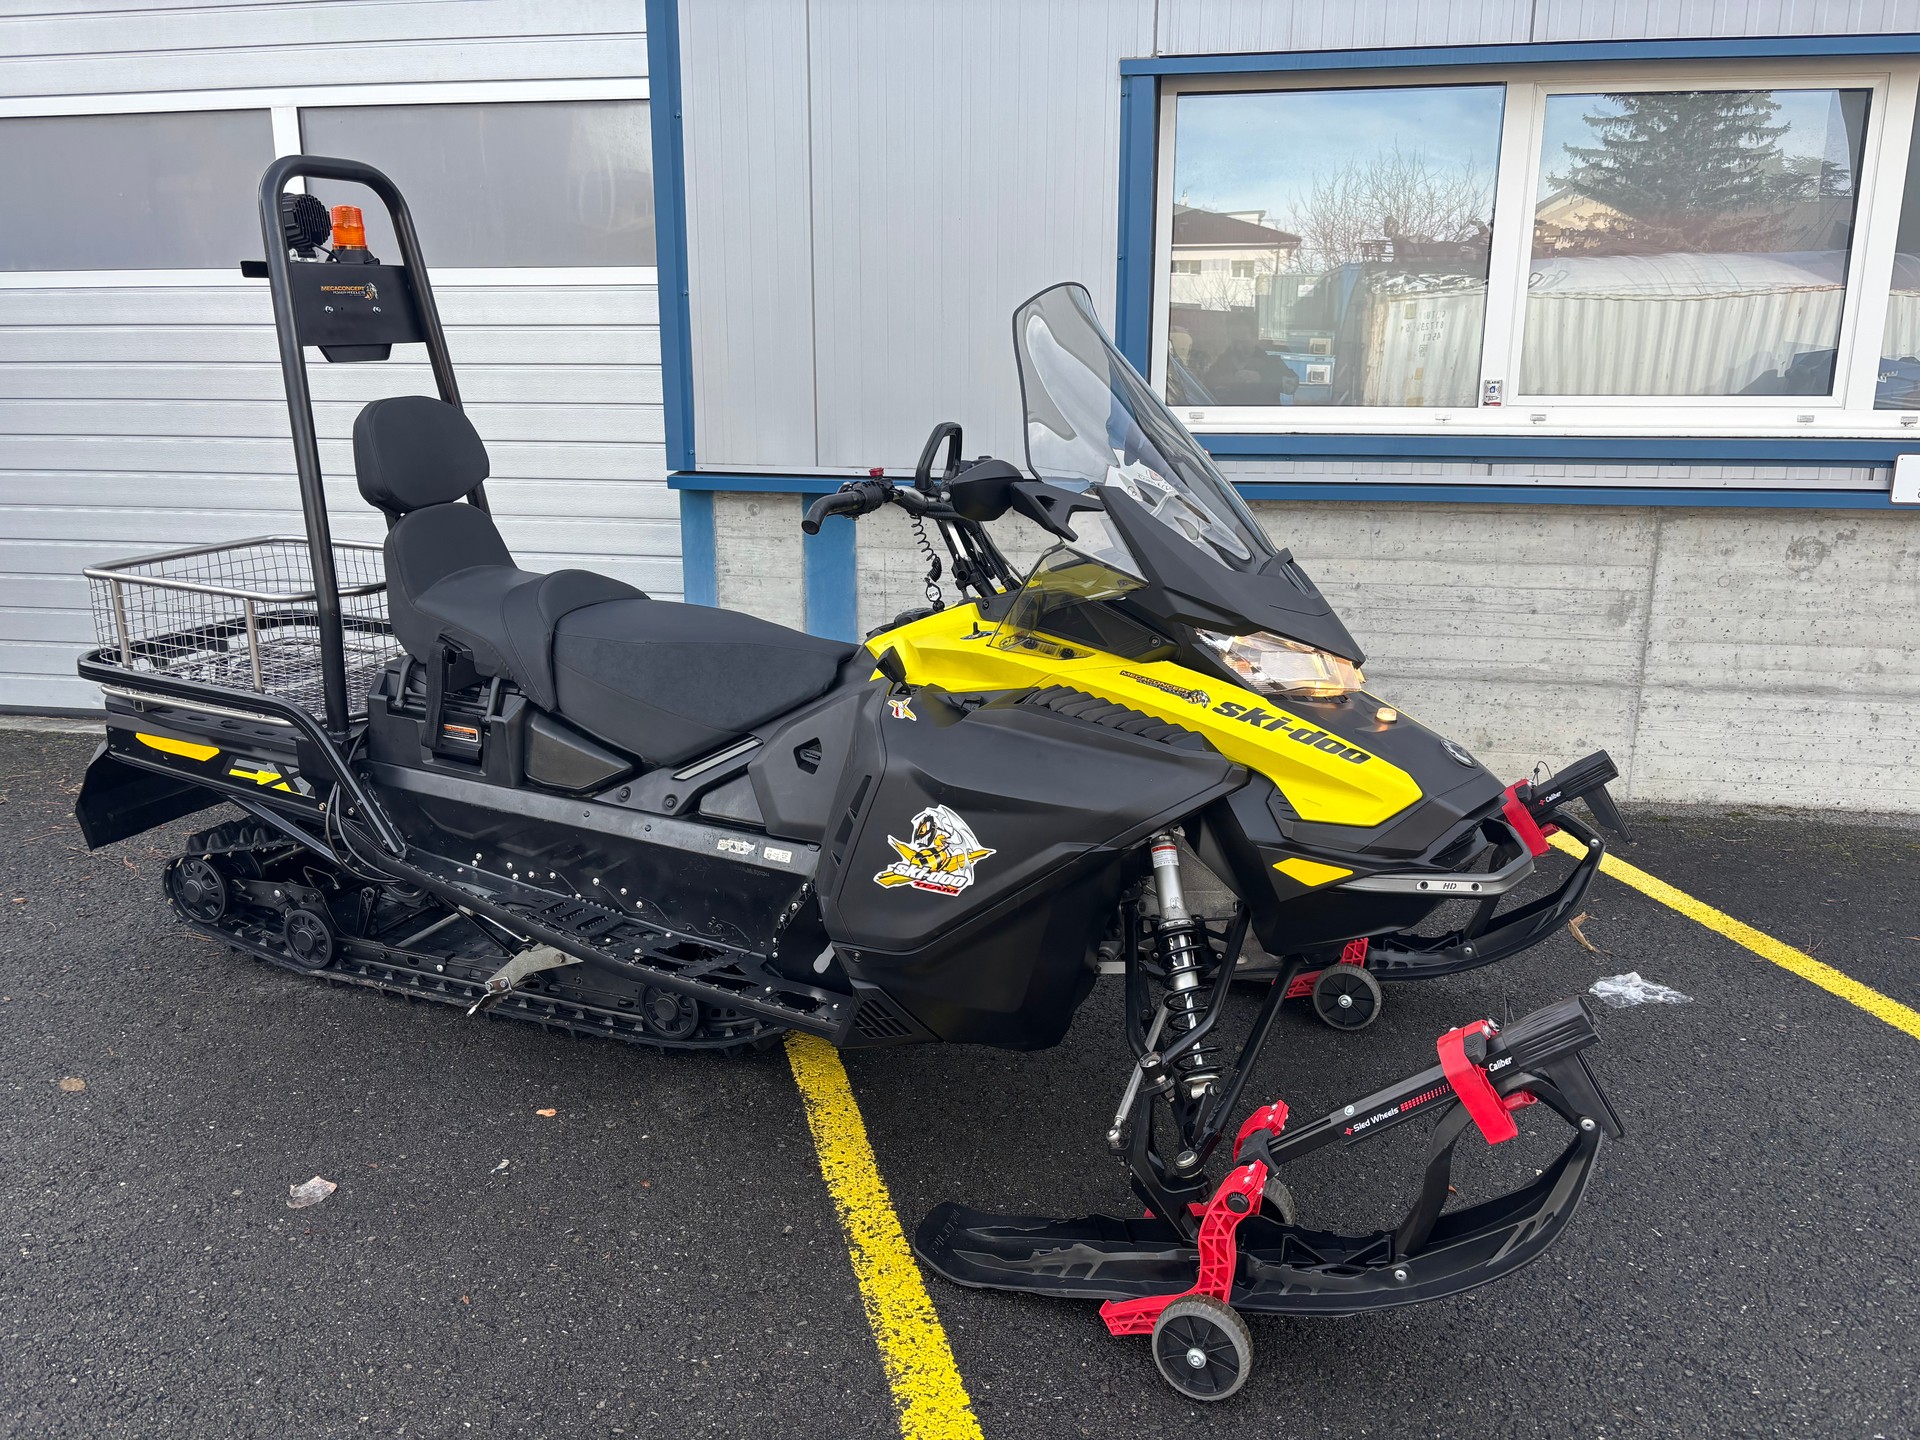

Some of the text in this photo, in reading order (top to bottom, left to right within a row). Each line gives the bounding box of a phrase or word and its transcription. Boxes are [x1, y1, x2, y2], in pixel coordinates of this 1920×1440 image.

[1212, 700, 1372, 765] ski-doo
[893, 863, 968, 888] ski-doo
[1442, 882, 1457, 890] HD
[1488, 1055, 1513, 1072] Caliber
[1353, 1107, 1399, 1133] Sled Wheels
